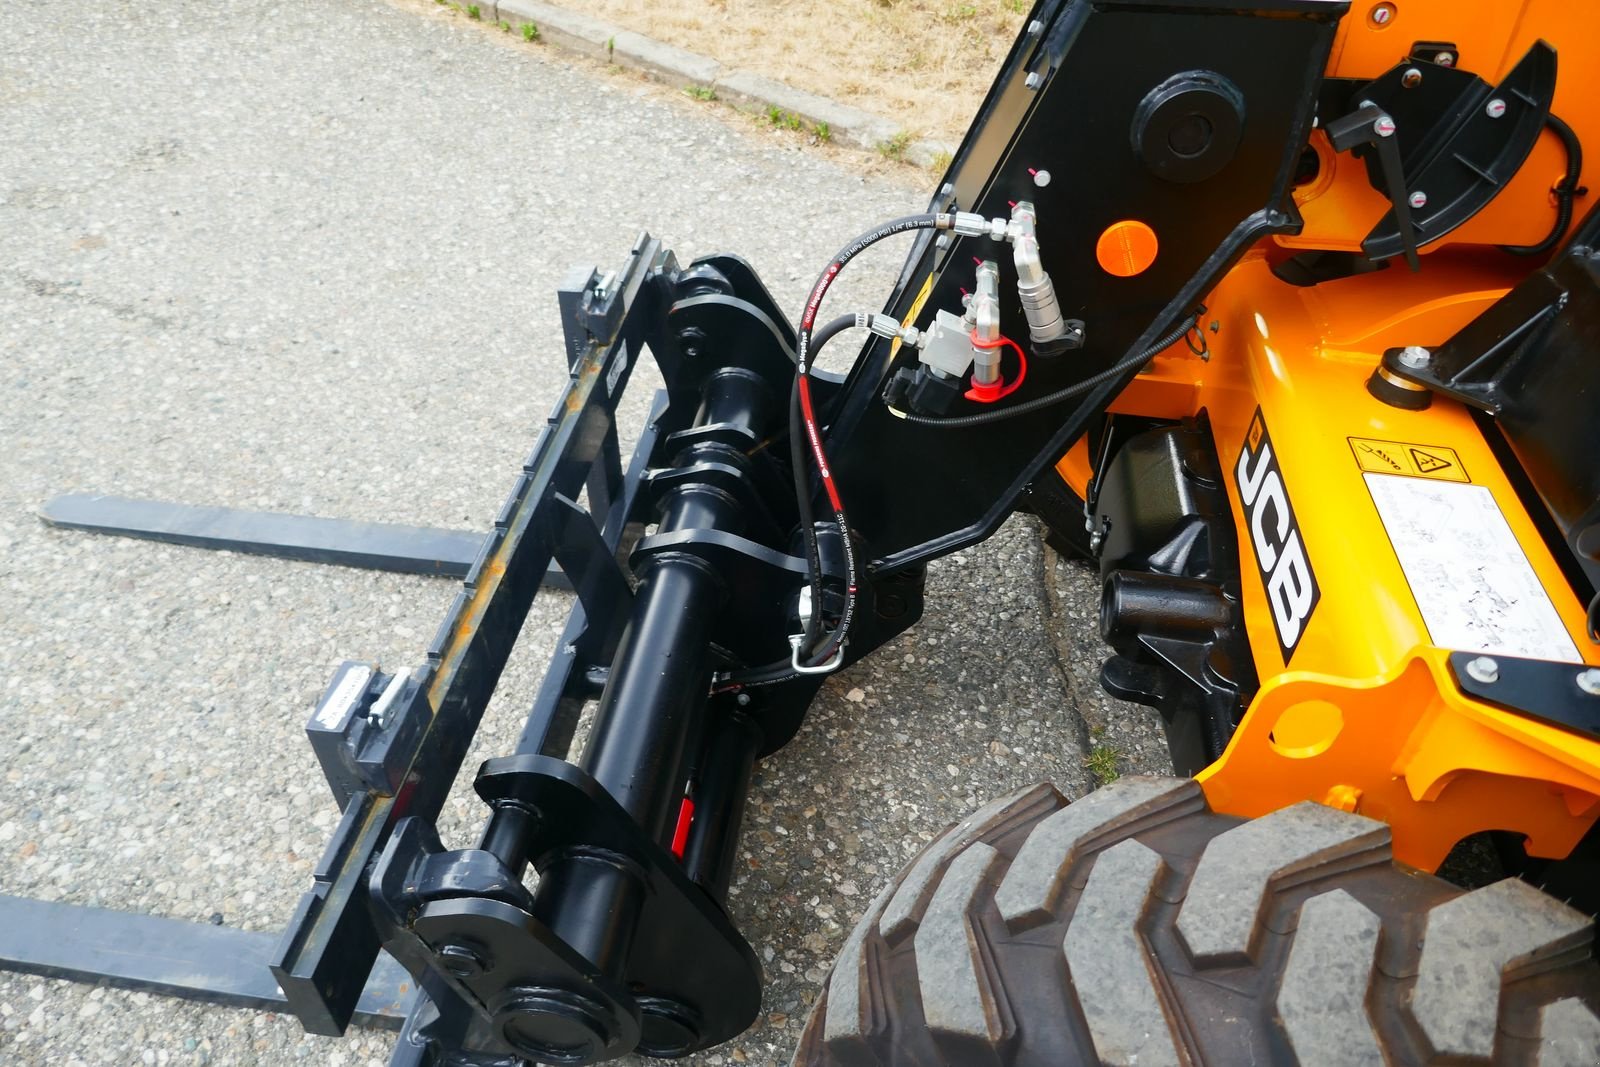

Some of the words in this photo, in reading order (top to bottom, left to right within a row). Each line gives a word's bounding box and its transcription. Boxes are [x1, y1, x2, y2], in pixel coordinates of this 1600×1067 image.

[840, 250, 851, 263] 35.0
[850, 244, 862, 254] MPa
[861, 233, 879, 247] (5000
[879, 227, 892, 237] PSI)
[905, 220, 919, 229] (6.3
[843, 533, 851, 548] MSHA
[1238, 443, 1313, 648] JCB
[846, 548, 855, 570] Resistant
